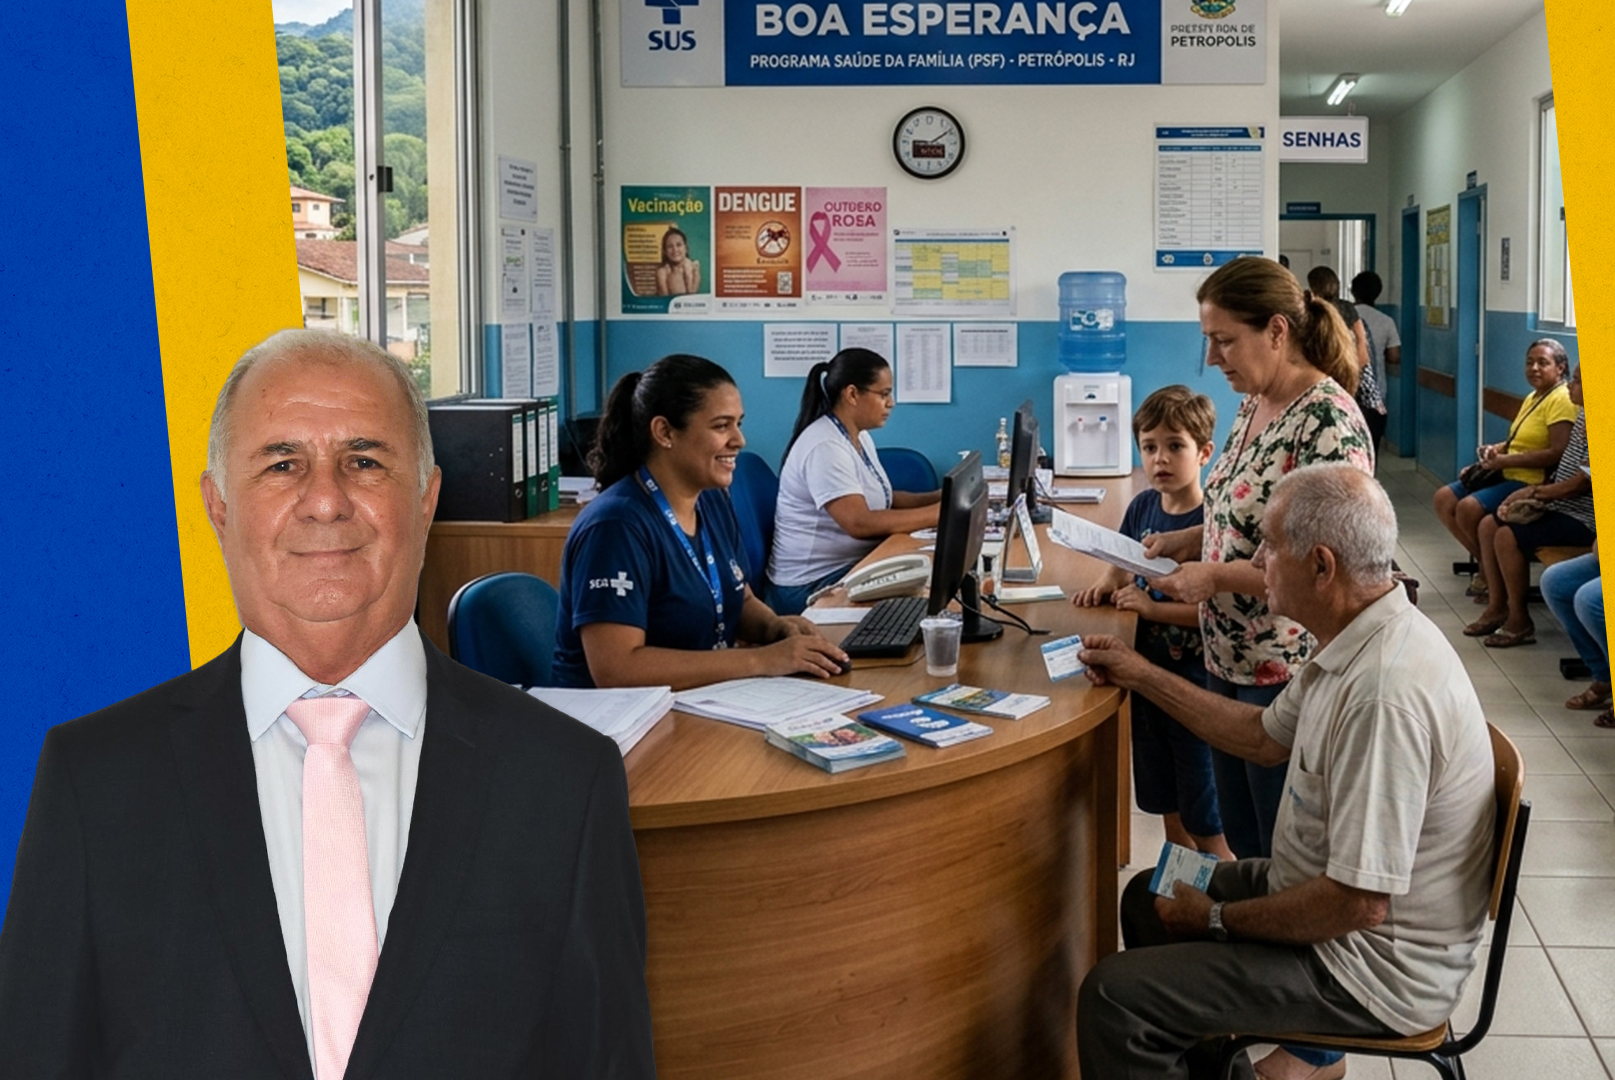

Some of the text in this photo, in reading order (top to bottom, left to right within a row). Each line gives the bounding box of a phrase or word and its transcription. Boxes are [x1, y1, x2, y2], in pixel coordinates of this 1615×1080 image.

[756, 2, 1132, 41] BOA ESPERANÇA
[648, 30, 697, 51] SUS
[1170, 35, 1257, 48] PETROPOLIS
[750, 54, 830, 69] PROGRAMA
[834, 51, 881, 68] SAÚDE
[884, 54, 905, 68] DA
[908, 51, 965, 68] FAMÍLIA
[968, 53, 1006, 69] (PSF)
[1018, 50, 1106, 68] PETRÓPOLIS
[1117, 53, 1136, 67] RJ
[1282, 131, 1362, 148] SENHAS
[627, 197, 704, 216] Vacinação
[718, 192, 797, 213] DENGUE
[832, 214, 877, 227] ROSA
